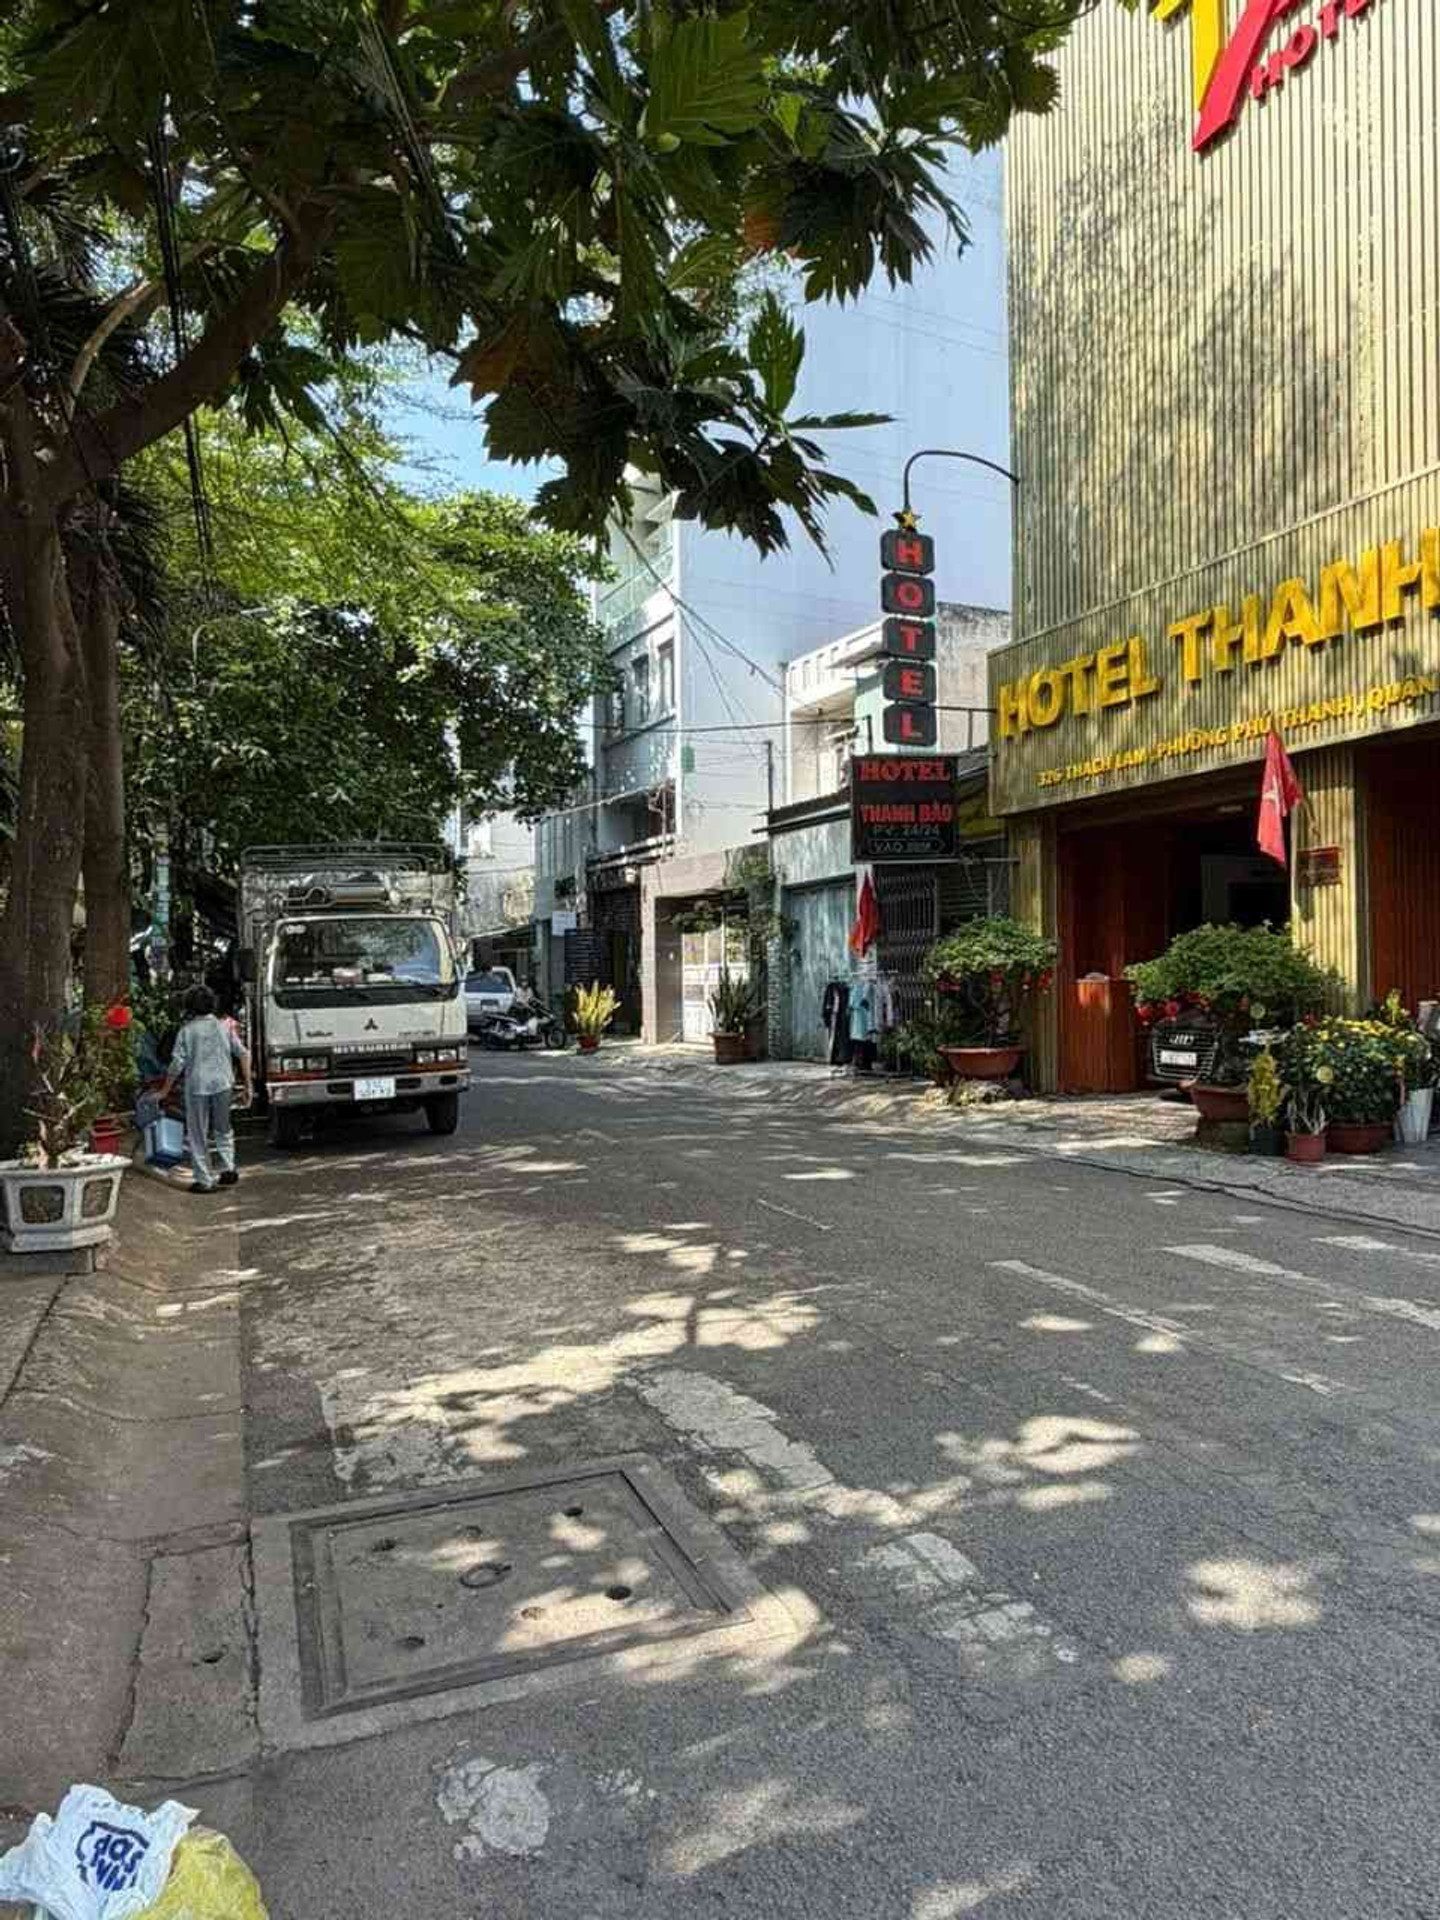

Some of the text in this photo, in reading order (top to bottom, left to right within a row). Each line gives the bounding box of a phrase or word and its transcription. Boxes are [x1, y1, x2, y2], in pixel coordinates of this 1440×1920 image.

[894, 538, 924, 738] HOTEL
[998, 525, 1440, 738] HOTEL THANH
[857, 759, 951, 781] HOTEL
